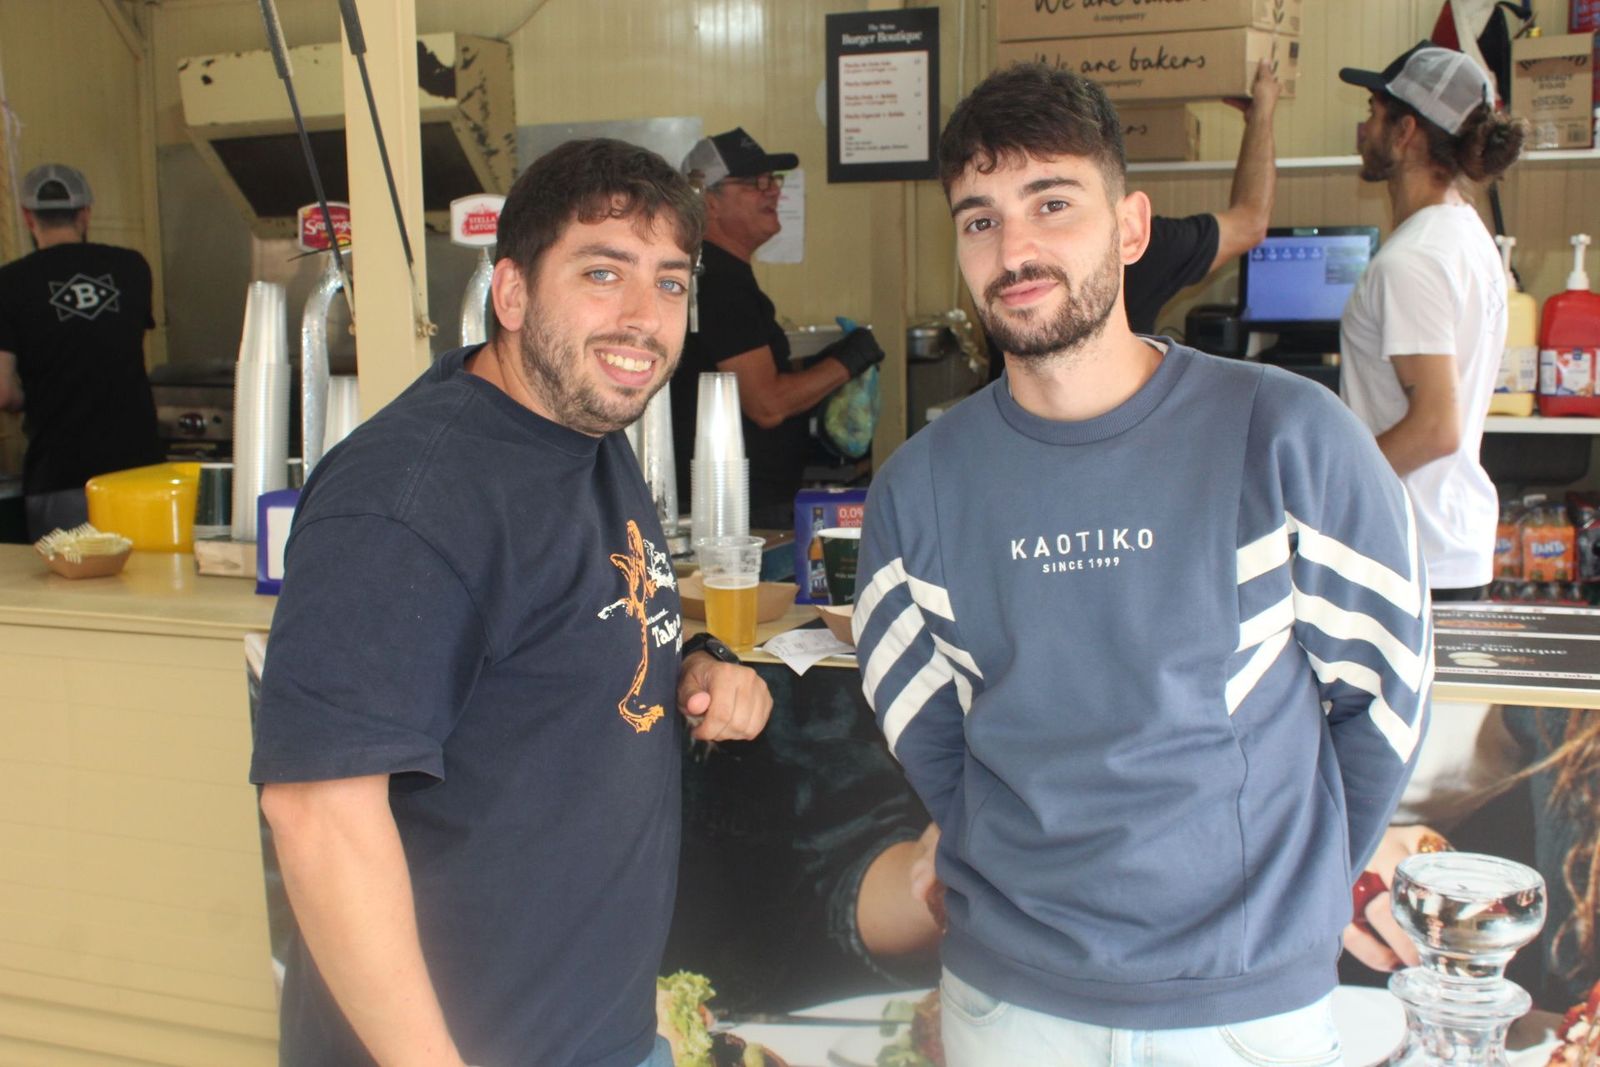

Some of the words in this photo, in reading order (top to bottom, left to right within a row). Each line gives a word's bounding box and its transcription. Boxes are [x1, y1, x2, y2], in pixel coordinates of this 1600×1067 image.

[842, 33, 876, 47] Burger
[877, 30, 923, 45] Boutique
[1080, 56, 1121, 74] are
[1129, 46, 1206, 71] bakers
[70, 283, 100, 310] B
[1010, 528, 1153, 560] KAOTIKO
[1531, 541, 1566, 555] FANTA
[1042, 559, 1084, 573] SINCE
[1089, 557, 1120, 569] 1999
[1481, 646, 1568, 655] Boutique
